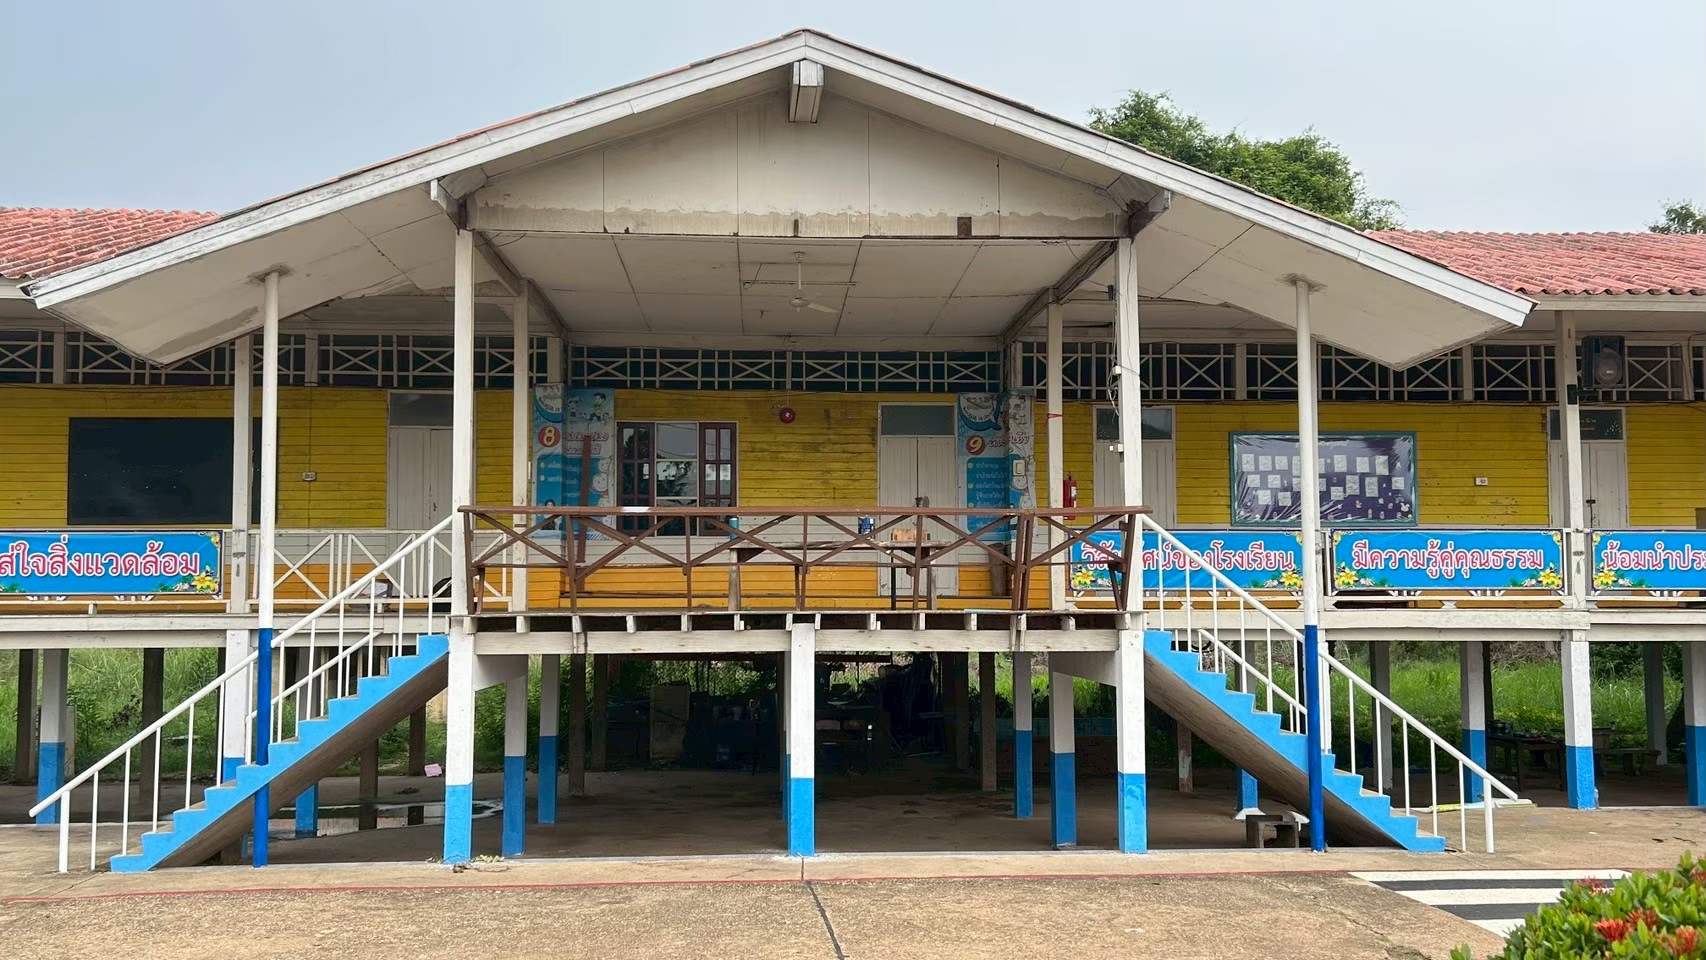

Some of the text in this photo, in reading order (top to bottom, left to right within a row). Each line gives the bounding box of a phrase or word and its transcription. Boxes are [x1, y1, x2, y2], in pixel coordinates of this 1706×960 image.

[543, 426, 555, 447] 8
[968, 436, 983, 454] 9
[1352, 539, 1544, 578] มีความรู้คู่คุณธรรม
